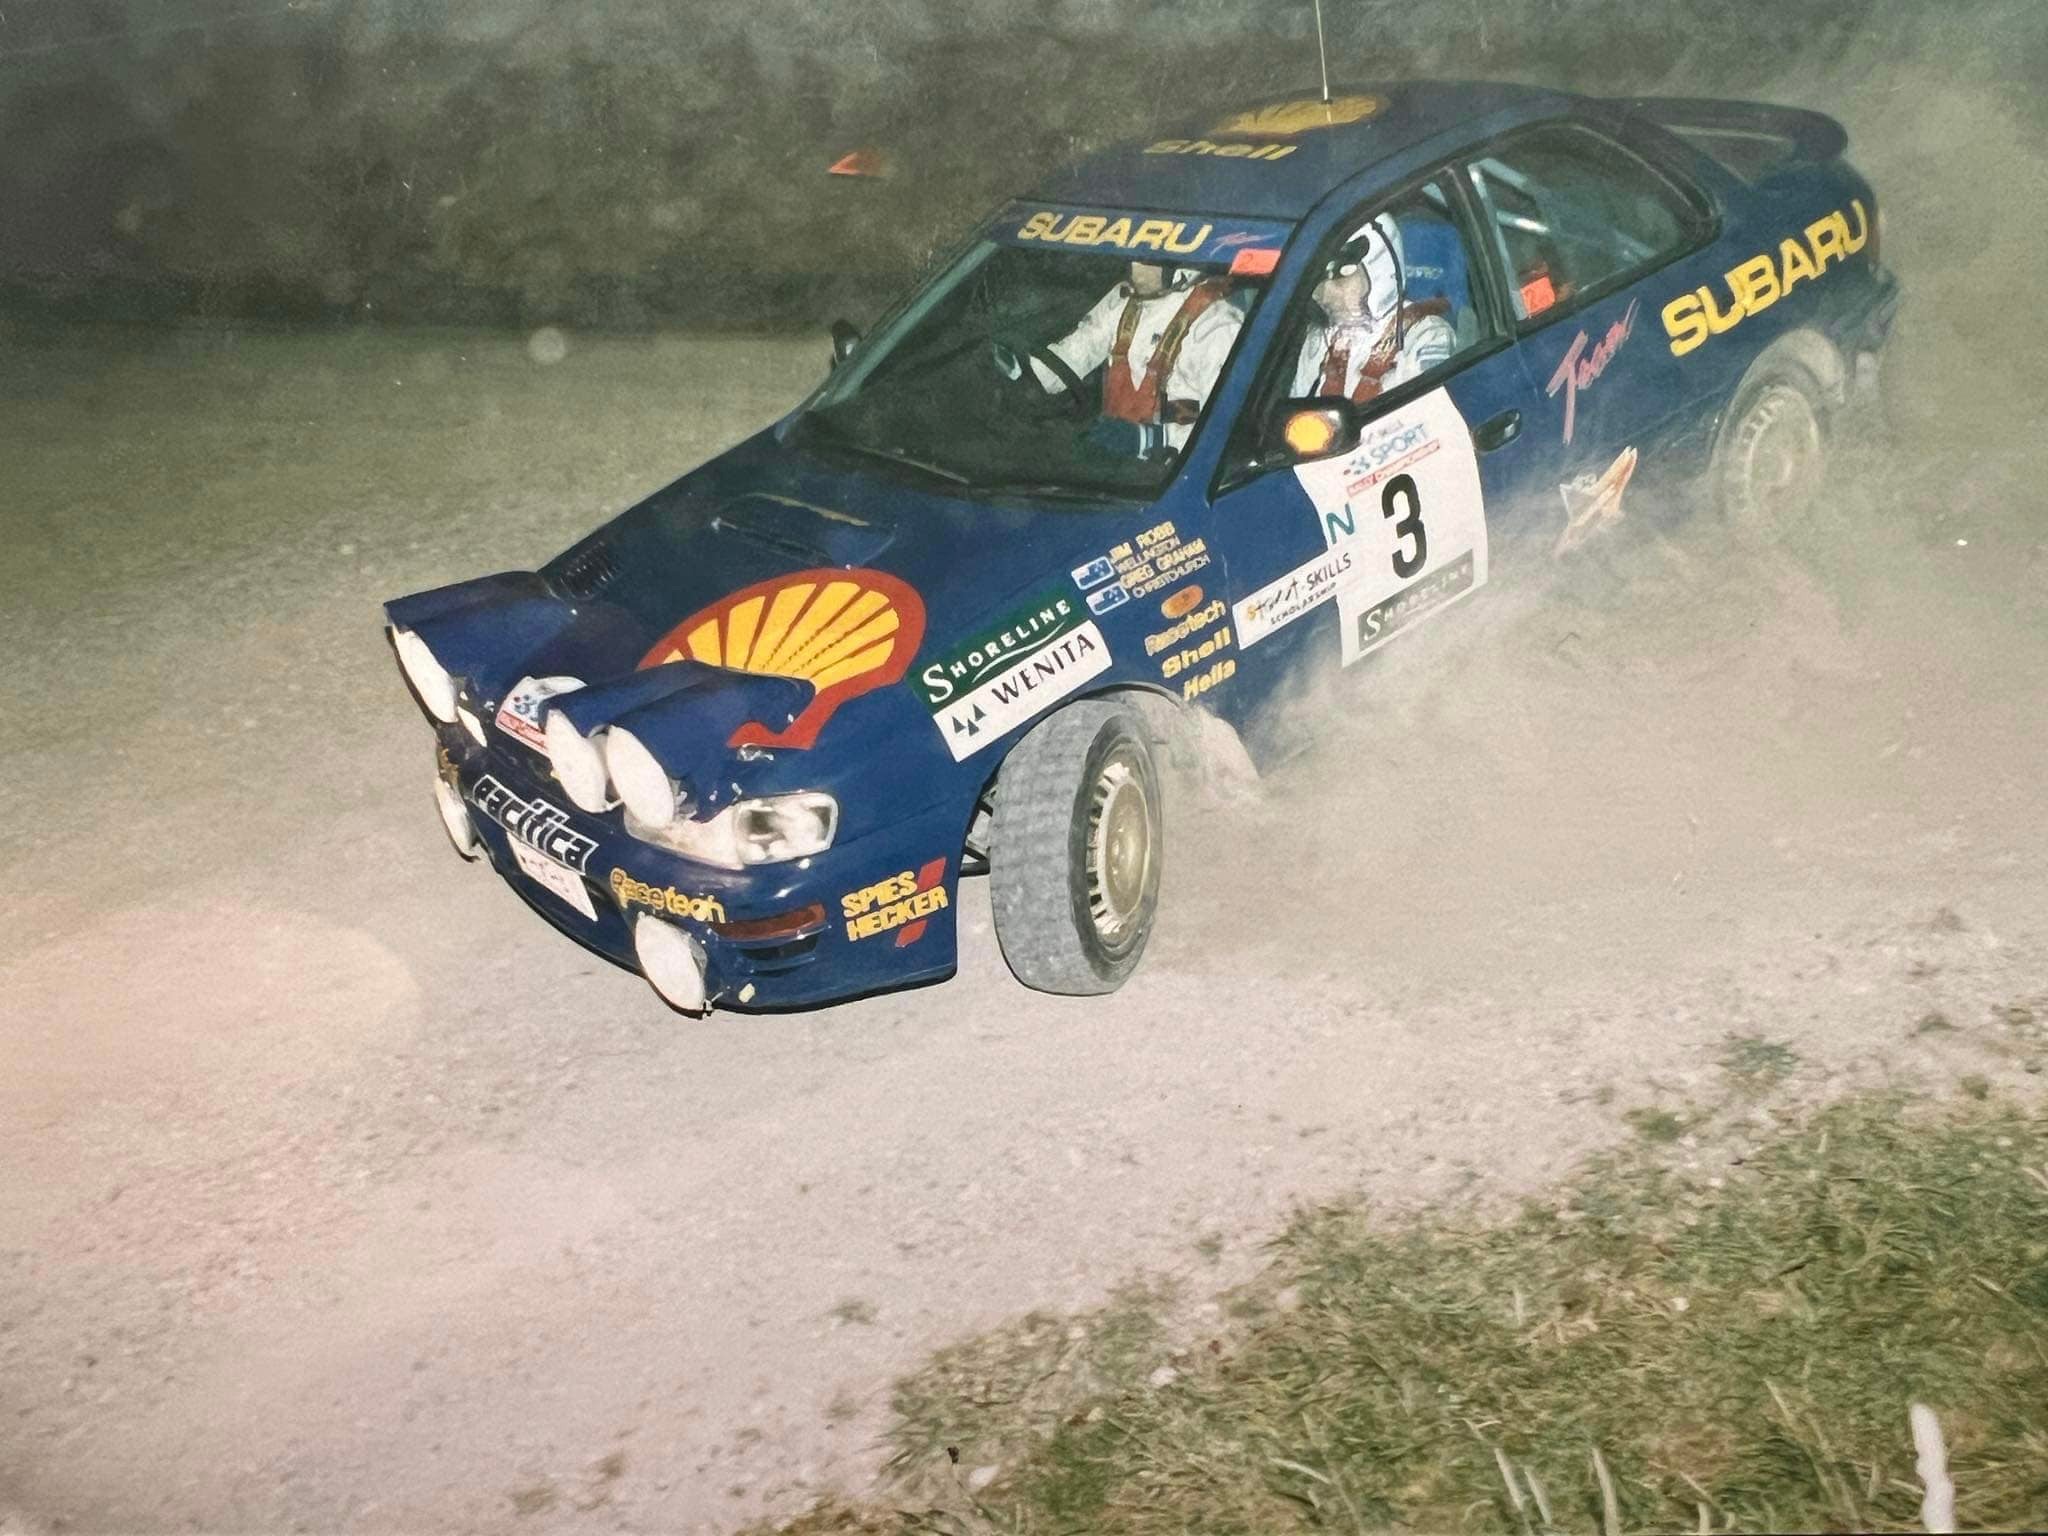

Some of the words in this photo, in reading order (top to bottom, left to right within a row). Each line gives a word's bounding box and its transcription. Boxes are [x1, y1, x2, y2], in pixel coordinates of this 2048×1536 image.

[1143, 139, 1298, 161] Shell
[1017, 211, 1213, 255] SUBARU
[1661, 199, 1869, 357] SUBARU
[1370, 422, 1427, 465] SPORT
[1382, 473, 1428, 579] 3
[1306, 552, 1352, 591] SKILLS
[922, 599, 1071, 703] SHORELINE
[991, 632, 1096, 705] WENITA
[1162, 626, 1232, 679] Shell
[1183, 659, 1237, 702] Hella
[841, 870, 918, 918] SPIES
[846, 885, 949, 942] HECKER
